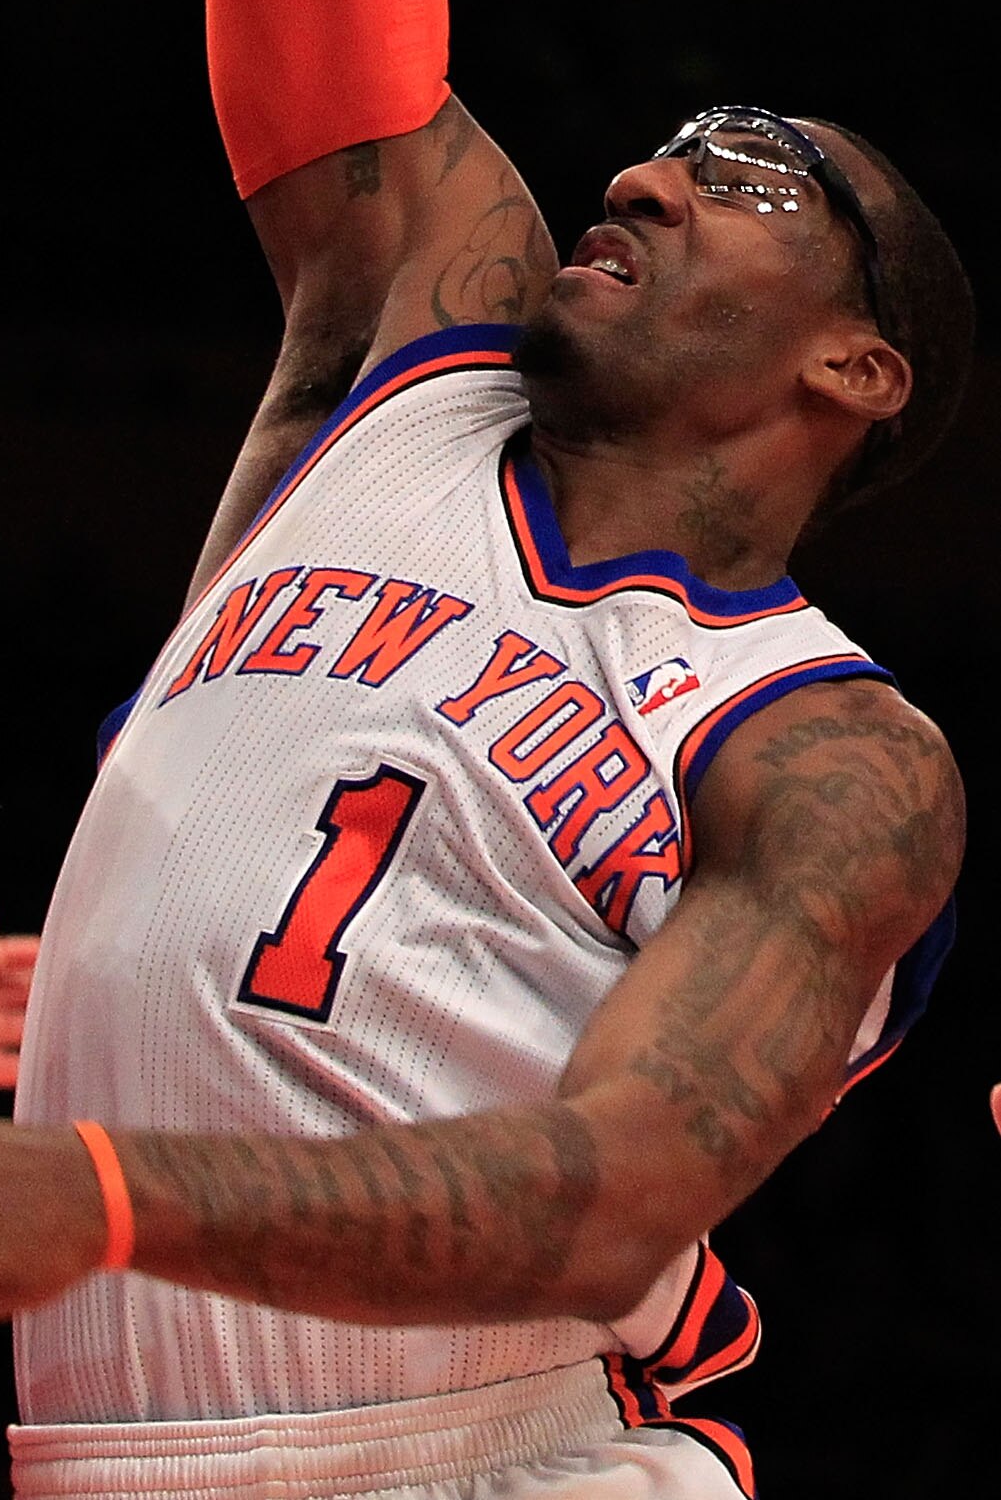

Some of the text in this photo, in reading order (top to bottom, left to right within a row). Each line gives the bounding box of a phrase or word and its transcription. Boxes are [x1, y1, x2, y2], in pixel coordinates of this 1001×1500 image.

[158, 564, 681, 951] NEW YORK
[236, 761, 428, 1024] 1
